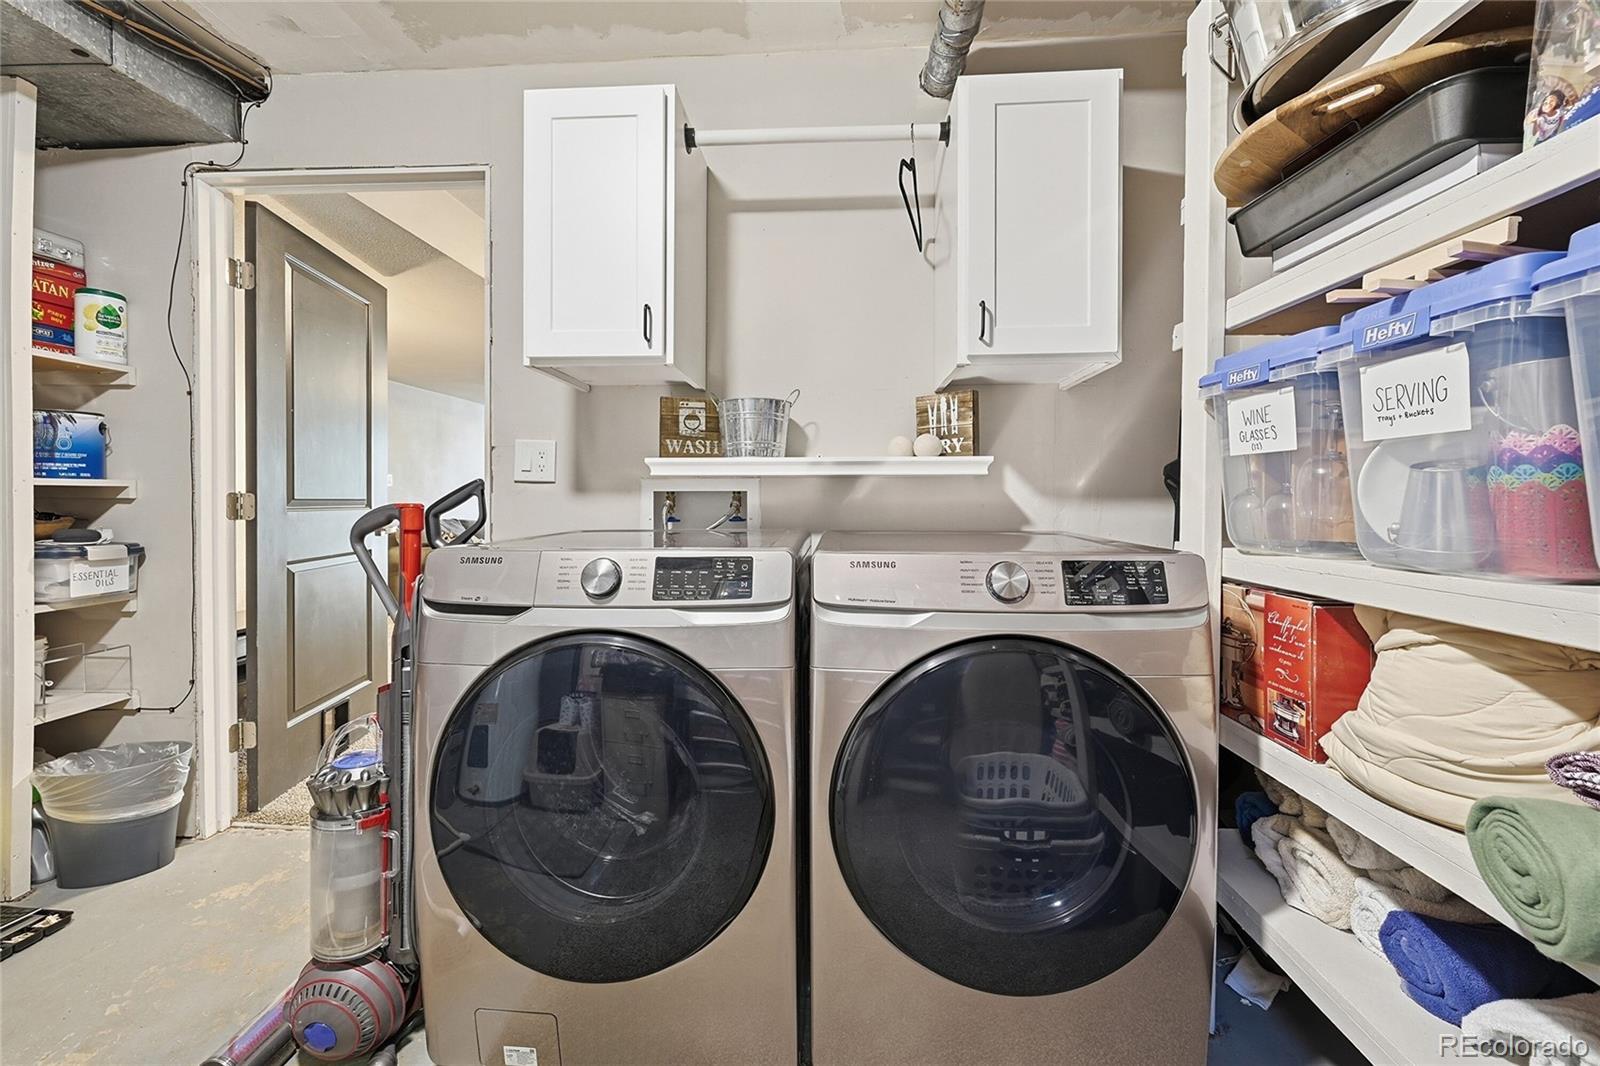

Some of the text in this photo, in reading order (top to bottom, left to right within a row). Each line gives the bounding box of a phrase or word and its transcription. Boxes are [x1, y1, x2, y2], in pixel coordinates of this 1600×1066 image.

[1364, 319, 1415, 343] Hefty
[1229, 368, 1259, 385] Hefty
[1372, 375, 1448, 412] SERVING
[1241, 404, 1272, 426] WINE
[1377, 414, 1396, 427] Trays
[1404, 407, 1434, 419] Buckets
[1239, 424, 1278, 443] GLASSES
[665, 439, 720, 454] WASH
[940, 437, 964, 453] RY
[459, 556, 503, 565] SAMSUNG
[849, 560, 896, 569] SAMSUNG
[72, 569, 119, 582] ESSENTIAL
[95, 577, 114, 588] OILS
